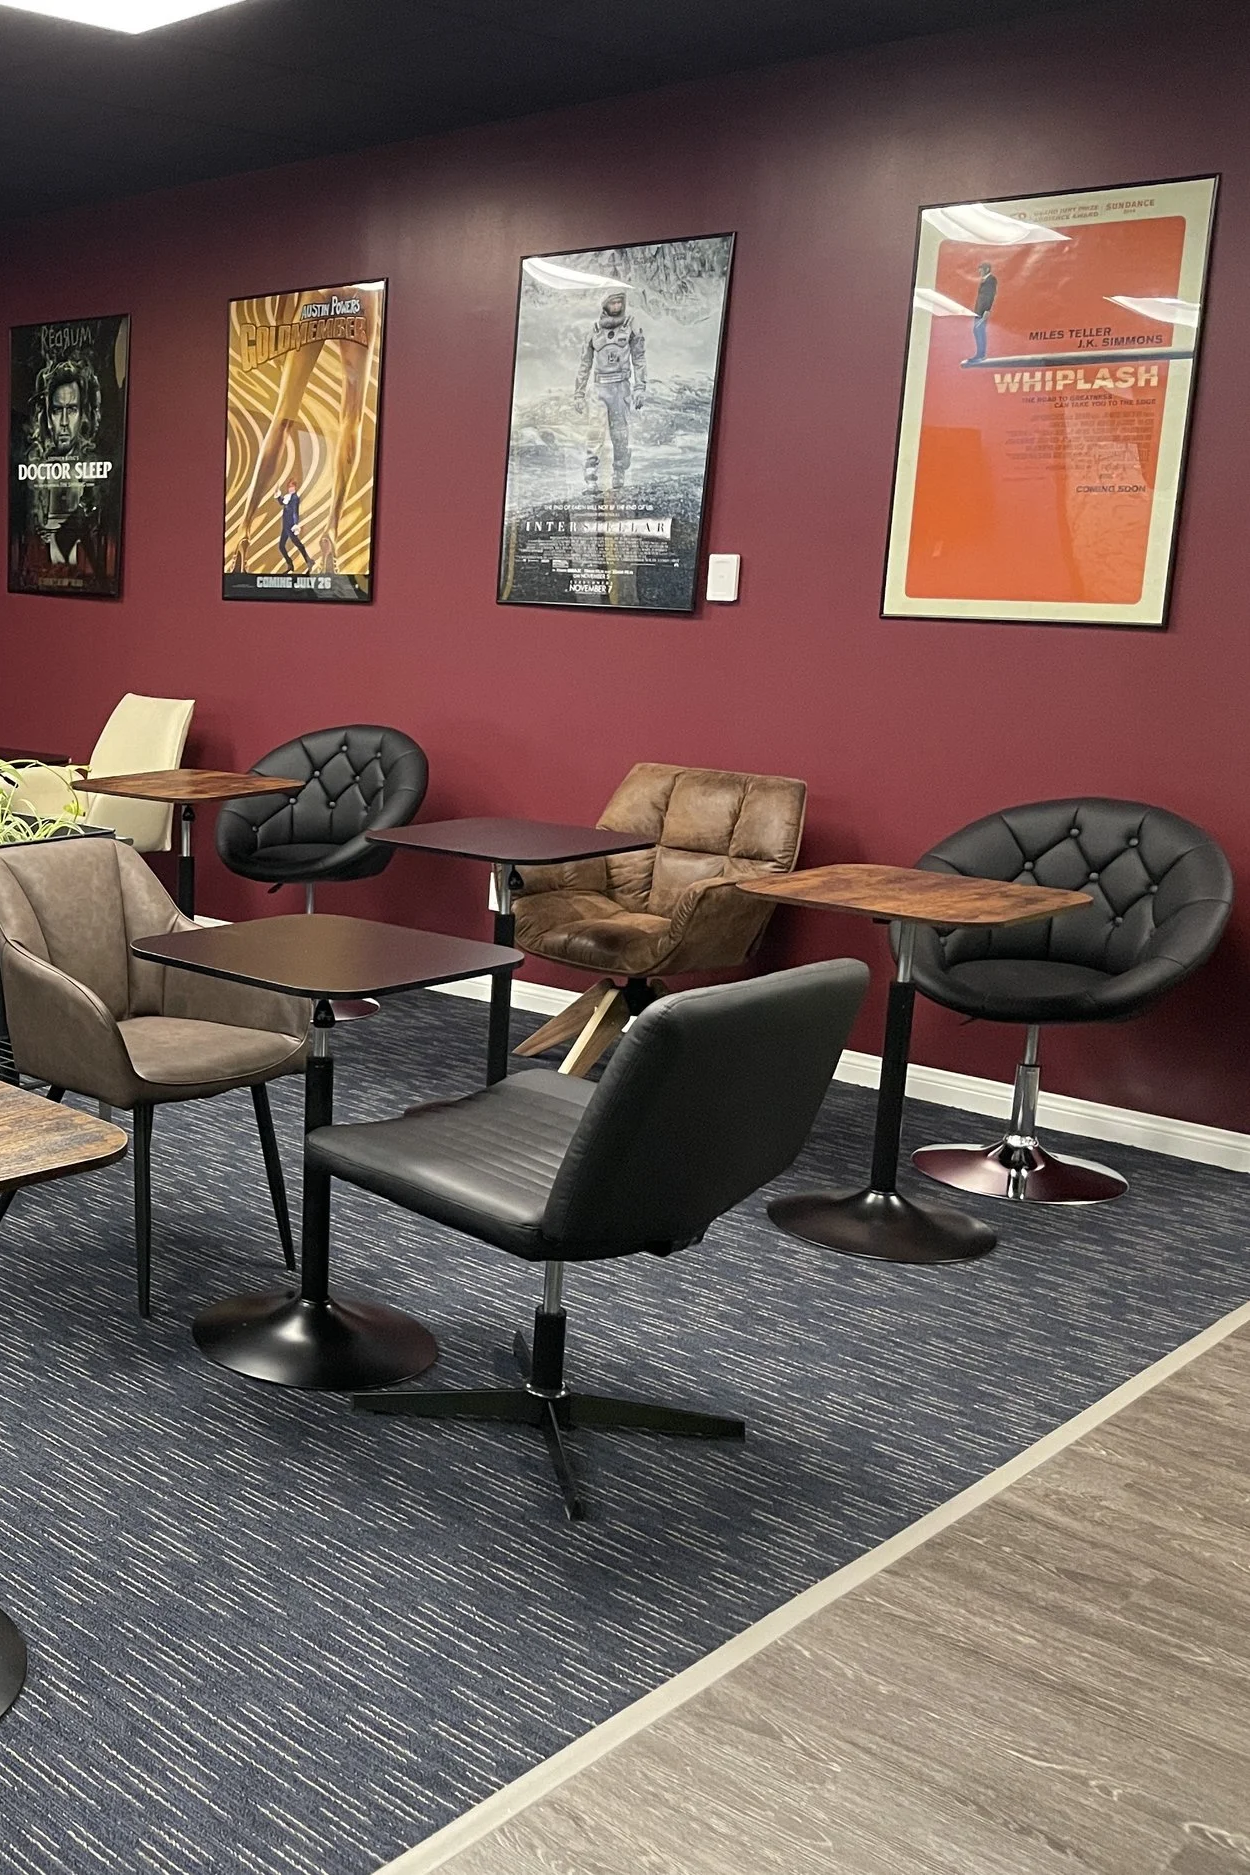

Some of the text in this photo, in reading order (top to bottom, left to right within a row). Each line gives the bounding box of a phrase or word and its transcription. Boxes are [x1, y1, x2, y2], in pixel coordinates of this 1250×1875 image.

[1106, 199, 1155, 211] SUNDANCE
[301, 304, 330, 319] AUSTIN
[1029, 327, 1111, 341] MILES TELLER
[240, 316, 368, 373] GOLDMEMBER
[1078, 335, 1163, 349] J.K. SIMMONS
[994, 366, 1159, 394] WHIPLASH
[18, 461, 113, 481] DOCTOR SLEEP
[1117, 485, 1146, 493] SOON
[256, 576, 331, 589] COMING JULY 26
[569, 584, 613, 593] NOVEMBER 7
